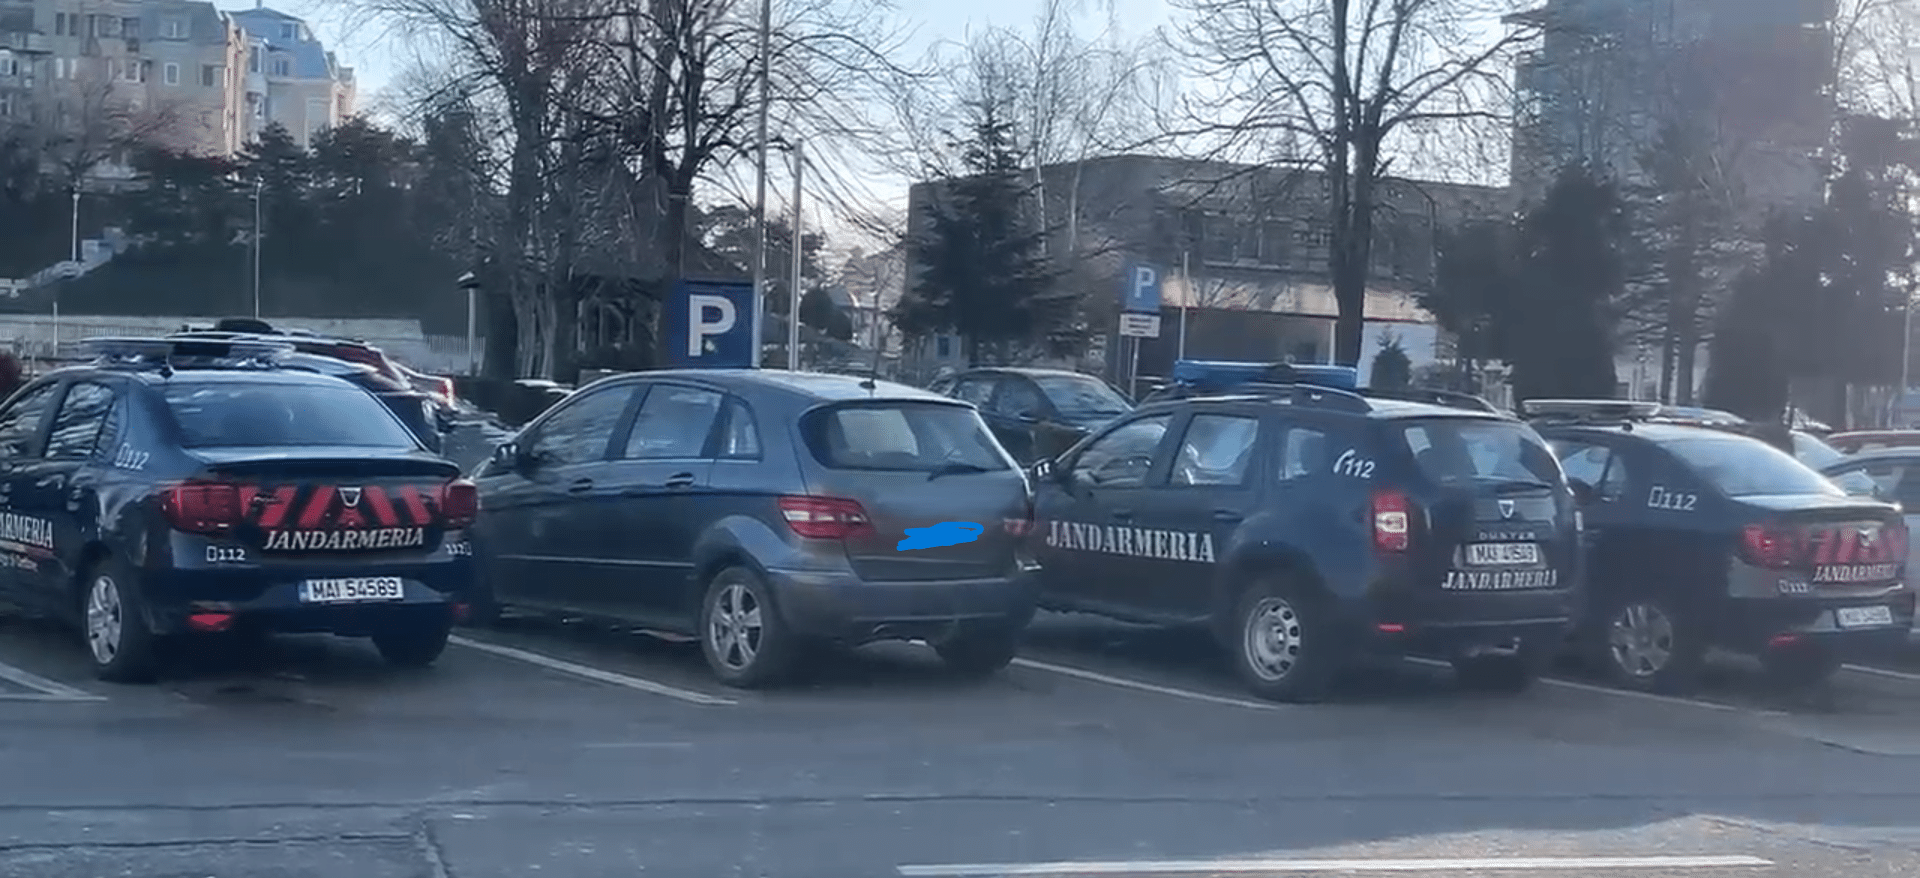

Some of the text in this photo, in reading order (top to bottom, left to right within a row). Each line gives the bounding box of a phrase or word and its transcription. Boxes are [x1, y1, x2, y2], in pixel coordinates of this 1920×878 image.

[1134, 267, 1155, 298] P
[689, 294, 736, 356] P
[1345, 458, 1375, 478] 112
[1661, 493, 1697, 511] 112
[263, 526, 425, 550] JANDARMERIA
[1046, 520, 1215, 563] JANDARMERIA
[218, 548, 245, 561] 112
[312, 580, 341, 598] MAI
[1441, 569, 1557, 590] JANDARMERIA
